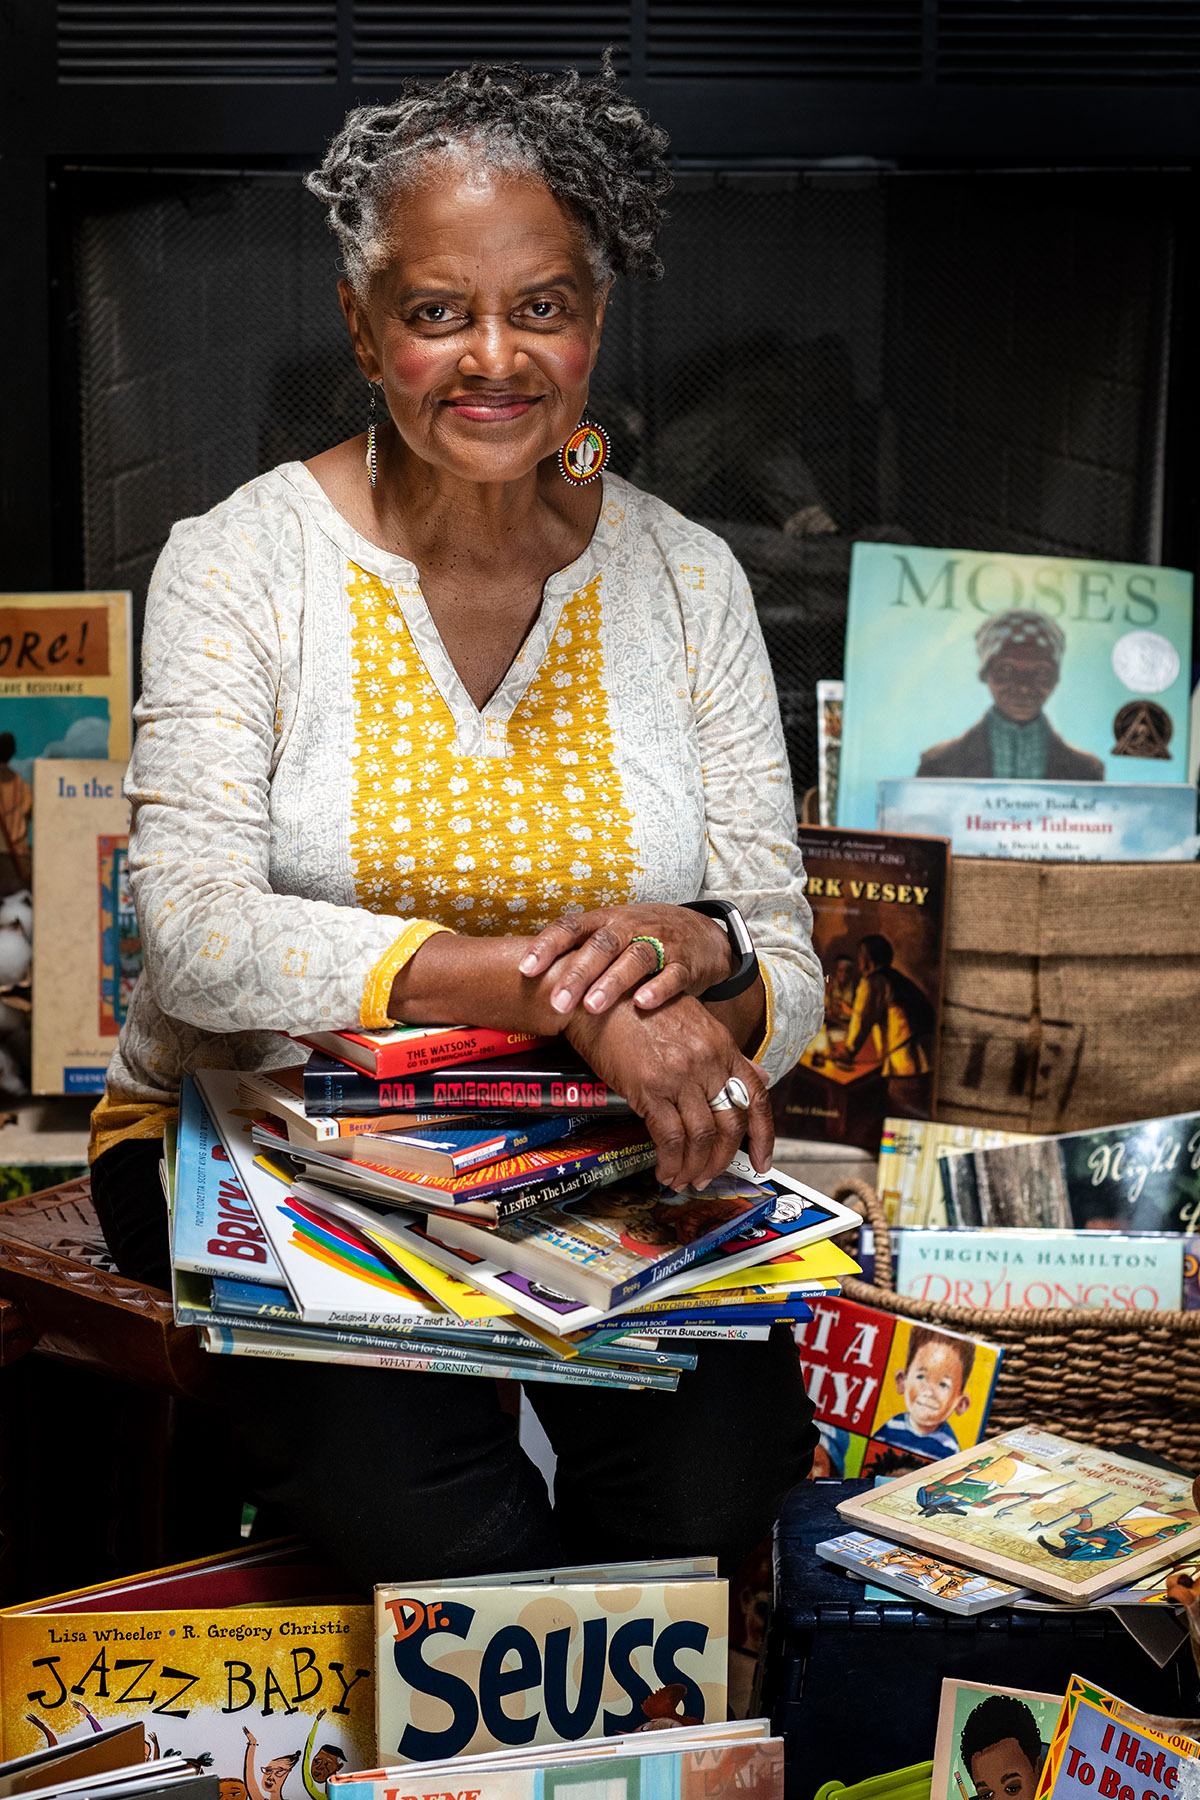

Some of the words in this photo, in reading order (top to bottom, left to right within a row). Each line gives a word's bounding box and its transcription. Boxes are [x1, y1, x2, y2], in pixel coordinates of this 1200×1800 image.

[890, 553, 1160, 627] MOSES
[58, 776, 77, 797] In
[84, 776, 114, 797] the
[1046, 799, 1079, 810] Book
[965, 815, 1032, 831] Harriet
[1037, 816, 1113, 833] Tubman
[849, 880, 930, 905] VESEY
[407, 1049, 426, 1060] THE
[430, 1039, 477, 1056] WATSONS
[379, 1084, 415, 1107] ALL
[434, 1082, 542, 1107] AMERICAN
[551, 1082, 607, 1107] BOYS
[349, 1123, 373, 1133] Berry
[197, 1166, 206, 1184] SCOTT
[1087, 1136, 1182, 1204] Night
[503, 1195, 537, 1216] LESTER
[540, 1185, 560, 1201] The
[561, 1175, 580, 1194] Last
[580, 1168, 603, 1186] Tales
[604, 1160, 614, 1176] of
[614, 1154, 641, 1171] Uncle
[195, 1185, 206, 1210] CORETTA
[195, 1211, 205, 1227] FROM
[651, 1247, 696, 1284] Taneesha
[919, 1247, 1025, 1266] VIRGINIA
[1037, 1251, 1159, 1269] HAMILTON
[193, 1265, 218, 1275] Smith
[908, 1267, 1160, 1311] DRYLONGSO
[656, 1302, 669, 1311] MY
[669, 1300, 693, 1310] CHILD
[693, 1298, 720, 1308] ABOUT
[720, 1297, 745, 1305] MEDIA
[328, 1312, 368, 1322] Designed
[369, 1313, 381, 1323] by
[382, 1314, 401, 1324] God
[414, 1315, 423, 1325] I
[423, 1317, 444, 1326] must
[445, 1318, 456, 1327] be
[492, 1334, 508, 1344] Ali
[678, 1328, 718, 1337] BUILDERS
[727, 1329, 748, 1339] Kids
[842, 1322, 879, 1367] A
[337, 1332, 348, 1342] In
[349, 1333, 362, 1343] for
[365, 1335, 398, 1349] Winter,
[400, 1339, 419, 1350] Out
[419, 1341, 435, 1353] for
[436, 1345, 468, 1359] Spring
[552, 1363, 586, 1374] Harcourt
[587, 1368, 608, 1377] Brace
[608, 1371, 652, 1384] Jovanovich
[379, 1357, 413, 1369] WHAT
[415, 1361, 423, 1369] A
[425, 1361, 483, 1374] MORNING!
[1077, 1467, 1104, 1480] The
[1131, 1484, 1163, 1497] Age
[48, 1628, 88, 1644] Lisa
[93, 1627, 163, 1643] Wheeler
[182, 1625, 201, 1640] R.
[207, 1624, 273, 1642] Gregory
[279, 1620, 350, 1637] Christie
[385, 1598, 450, 1643] Dr.
[26, 1646, 200, 1720] JAZZ
[221, 1647, 371, 1717] BABY
[393, 1598, 710, 1762] Seuss
[1100, 1723, 1116, 1754] I
[1115, 1731, 1180, 1790] Hate
[1066, 1745, 1096, 1786] To
[1097, 1765, 1135, 1800] Be
